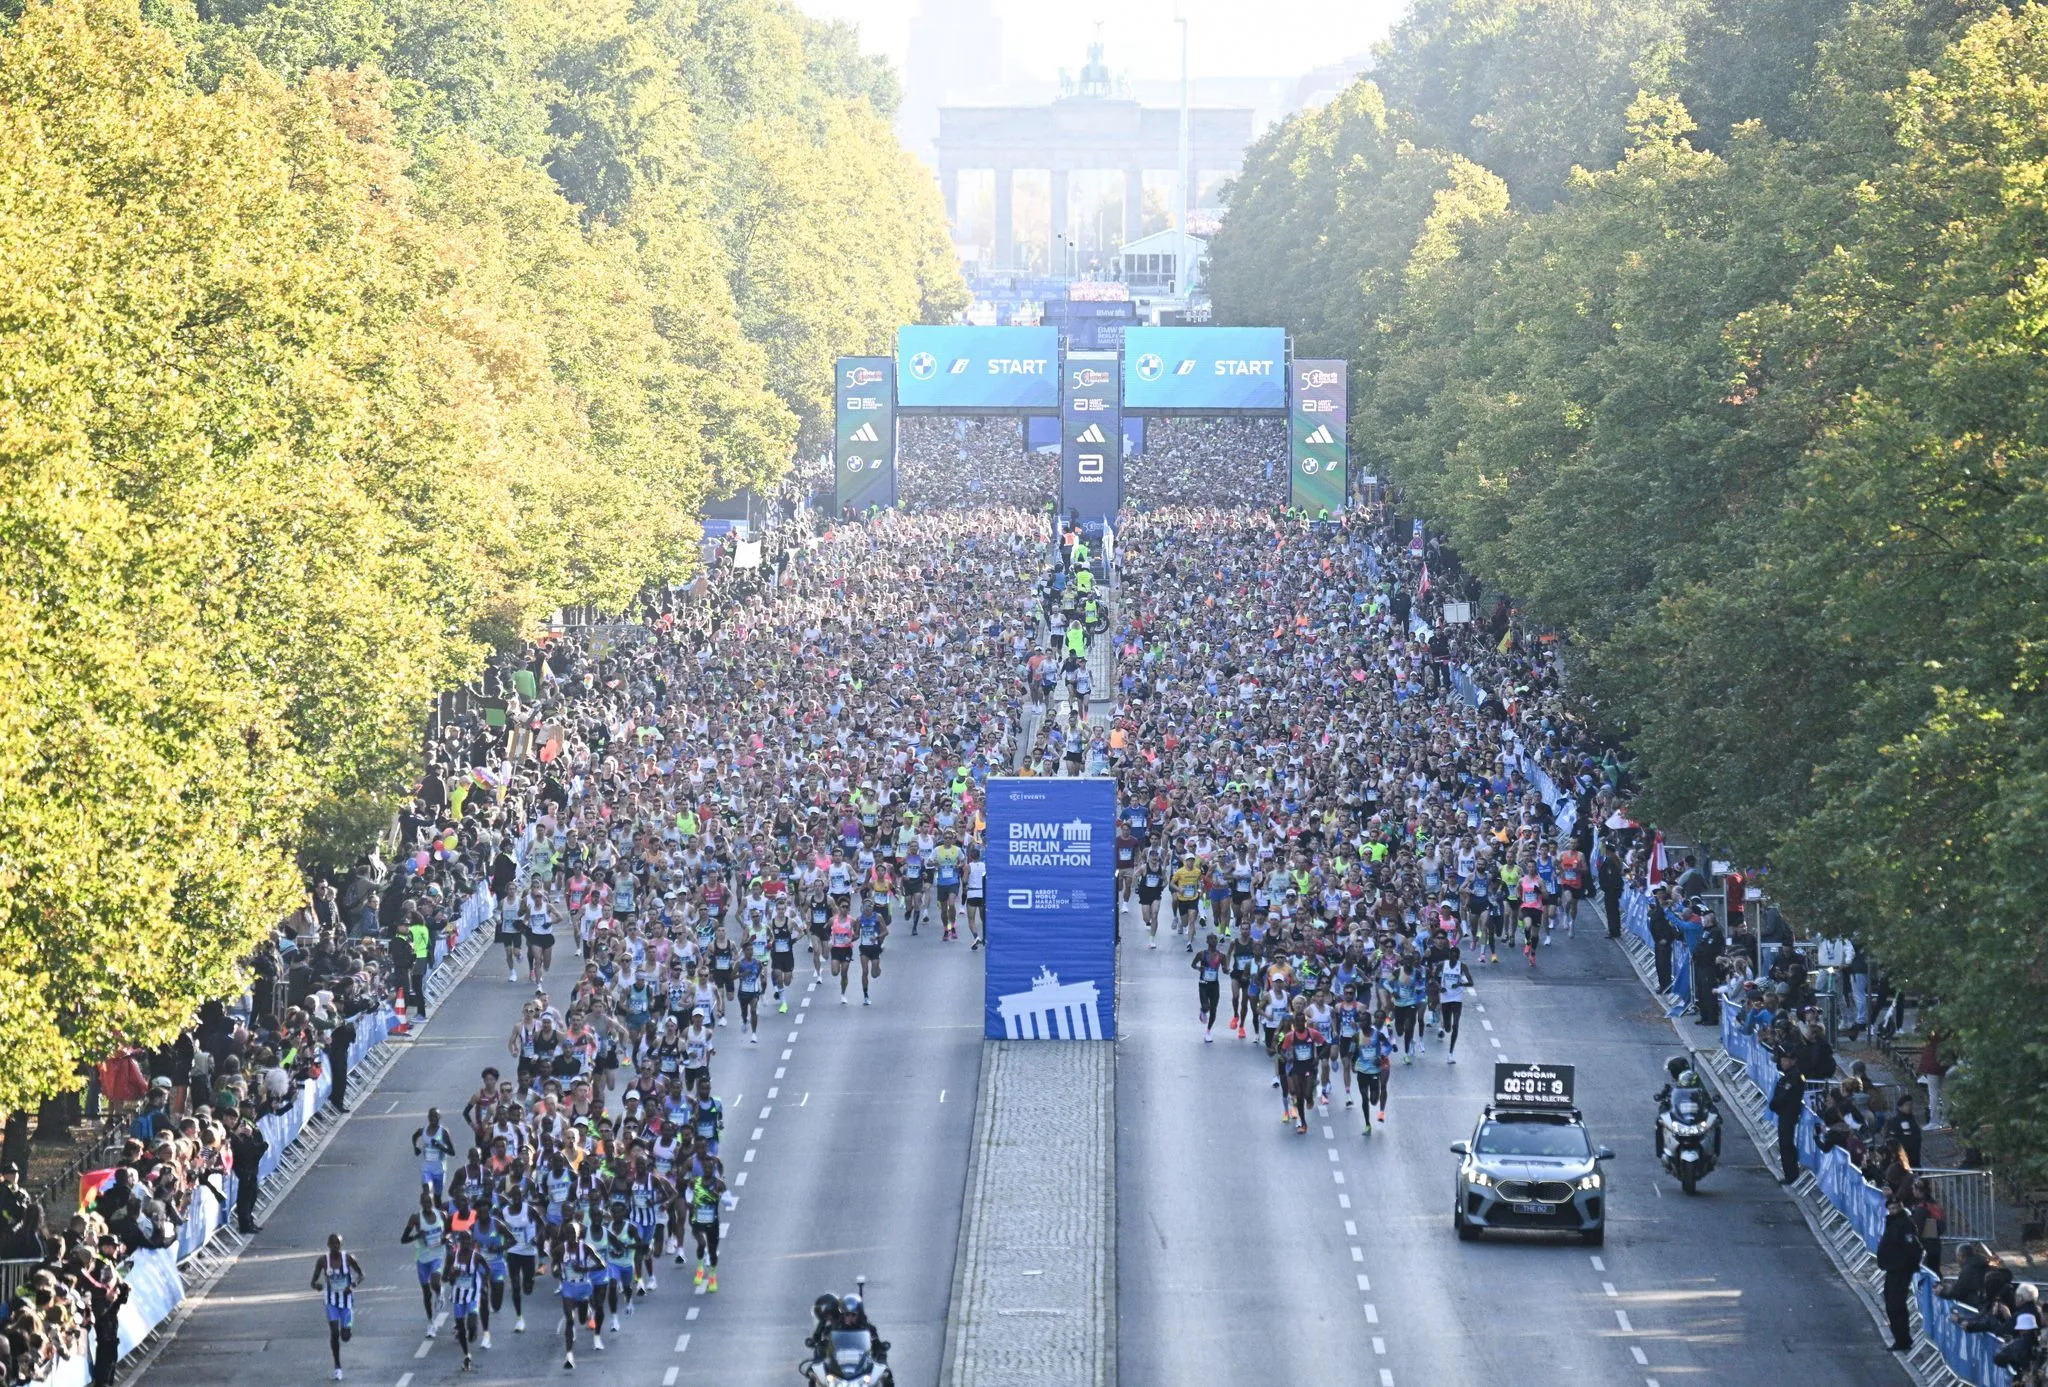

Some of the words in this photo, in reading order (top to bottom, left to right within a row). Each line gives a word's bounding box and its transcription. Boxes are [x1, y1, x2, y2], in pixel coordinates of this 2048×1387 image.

[988, 358, 1047, 375] START
[1215, 359, 1274, 376] START
[1009, 823, 1060, 839] BMW
[1009, 841, 1060, 853] BERLIN
[1009, 854, 1091, 866] MARATHON
